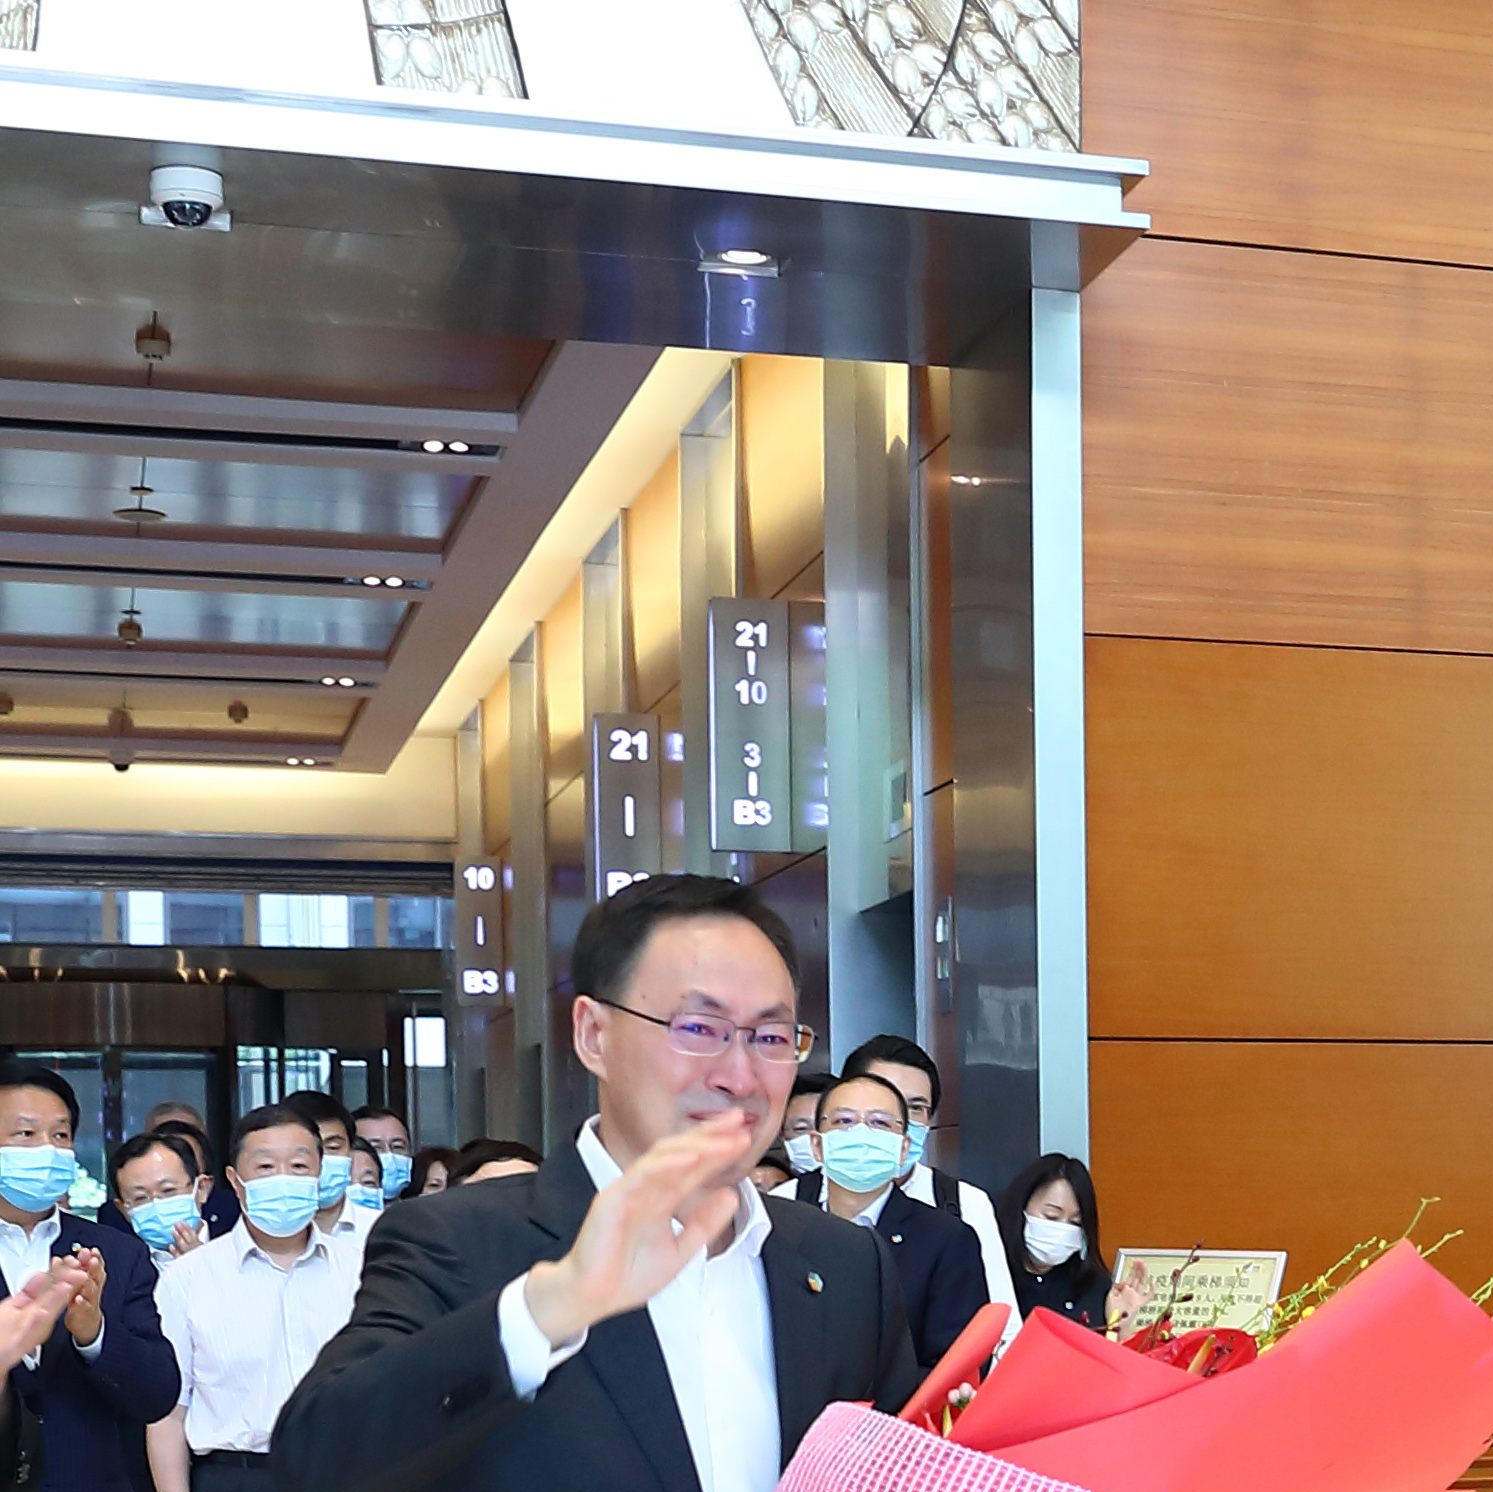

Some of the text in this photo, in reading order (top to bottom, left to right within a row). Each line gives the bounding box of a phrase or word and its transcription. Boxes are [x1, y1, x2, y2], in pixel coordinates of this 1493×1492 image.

[735, 621, 768, 647] 21
[734, 679, 768, 705] 10
[610, 729, 648, 761] 21
[743, 743, 762, 768] 3
[733, 799, 772, 826] B3
[463, 866, 495, 890] 10
[463, 970, 499, 994] B3
